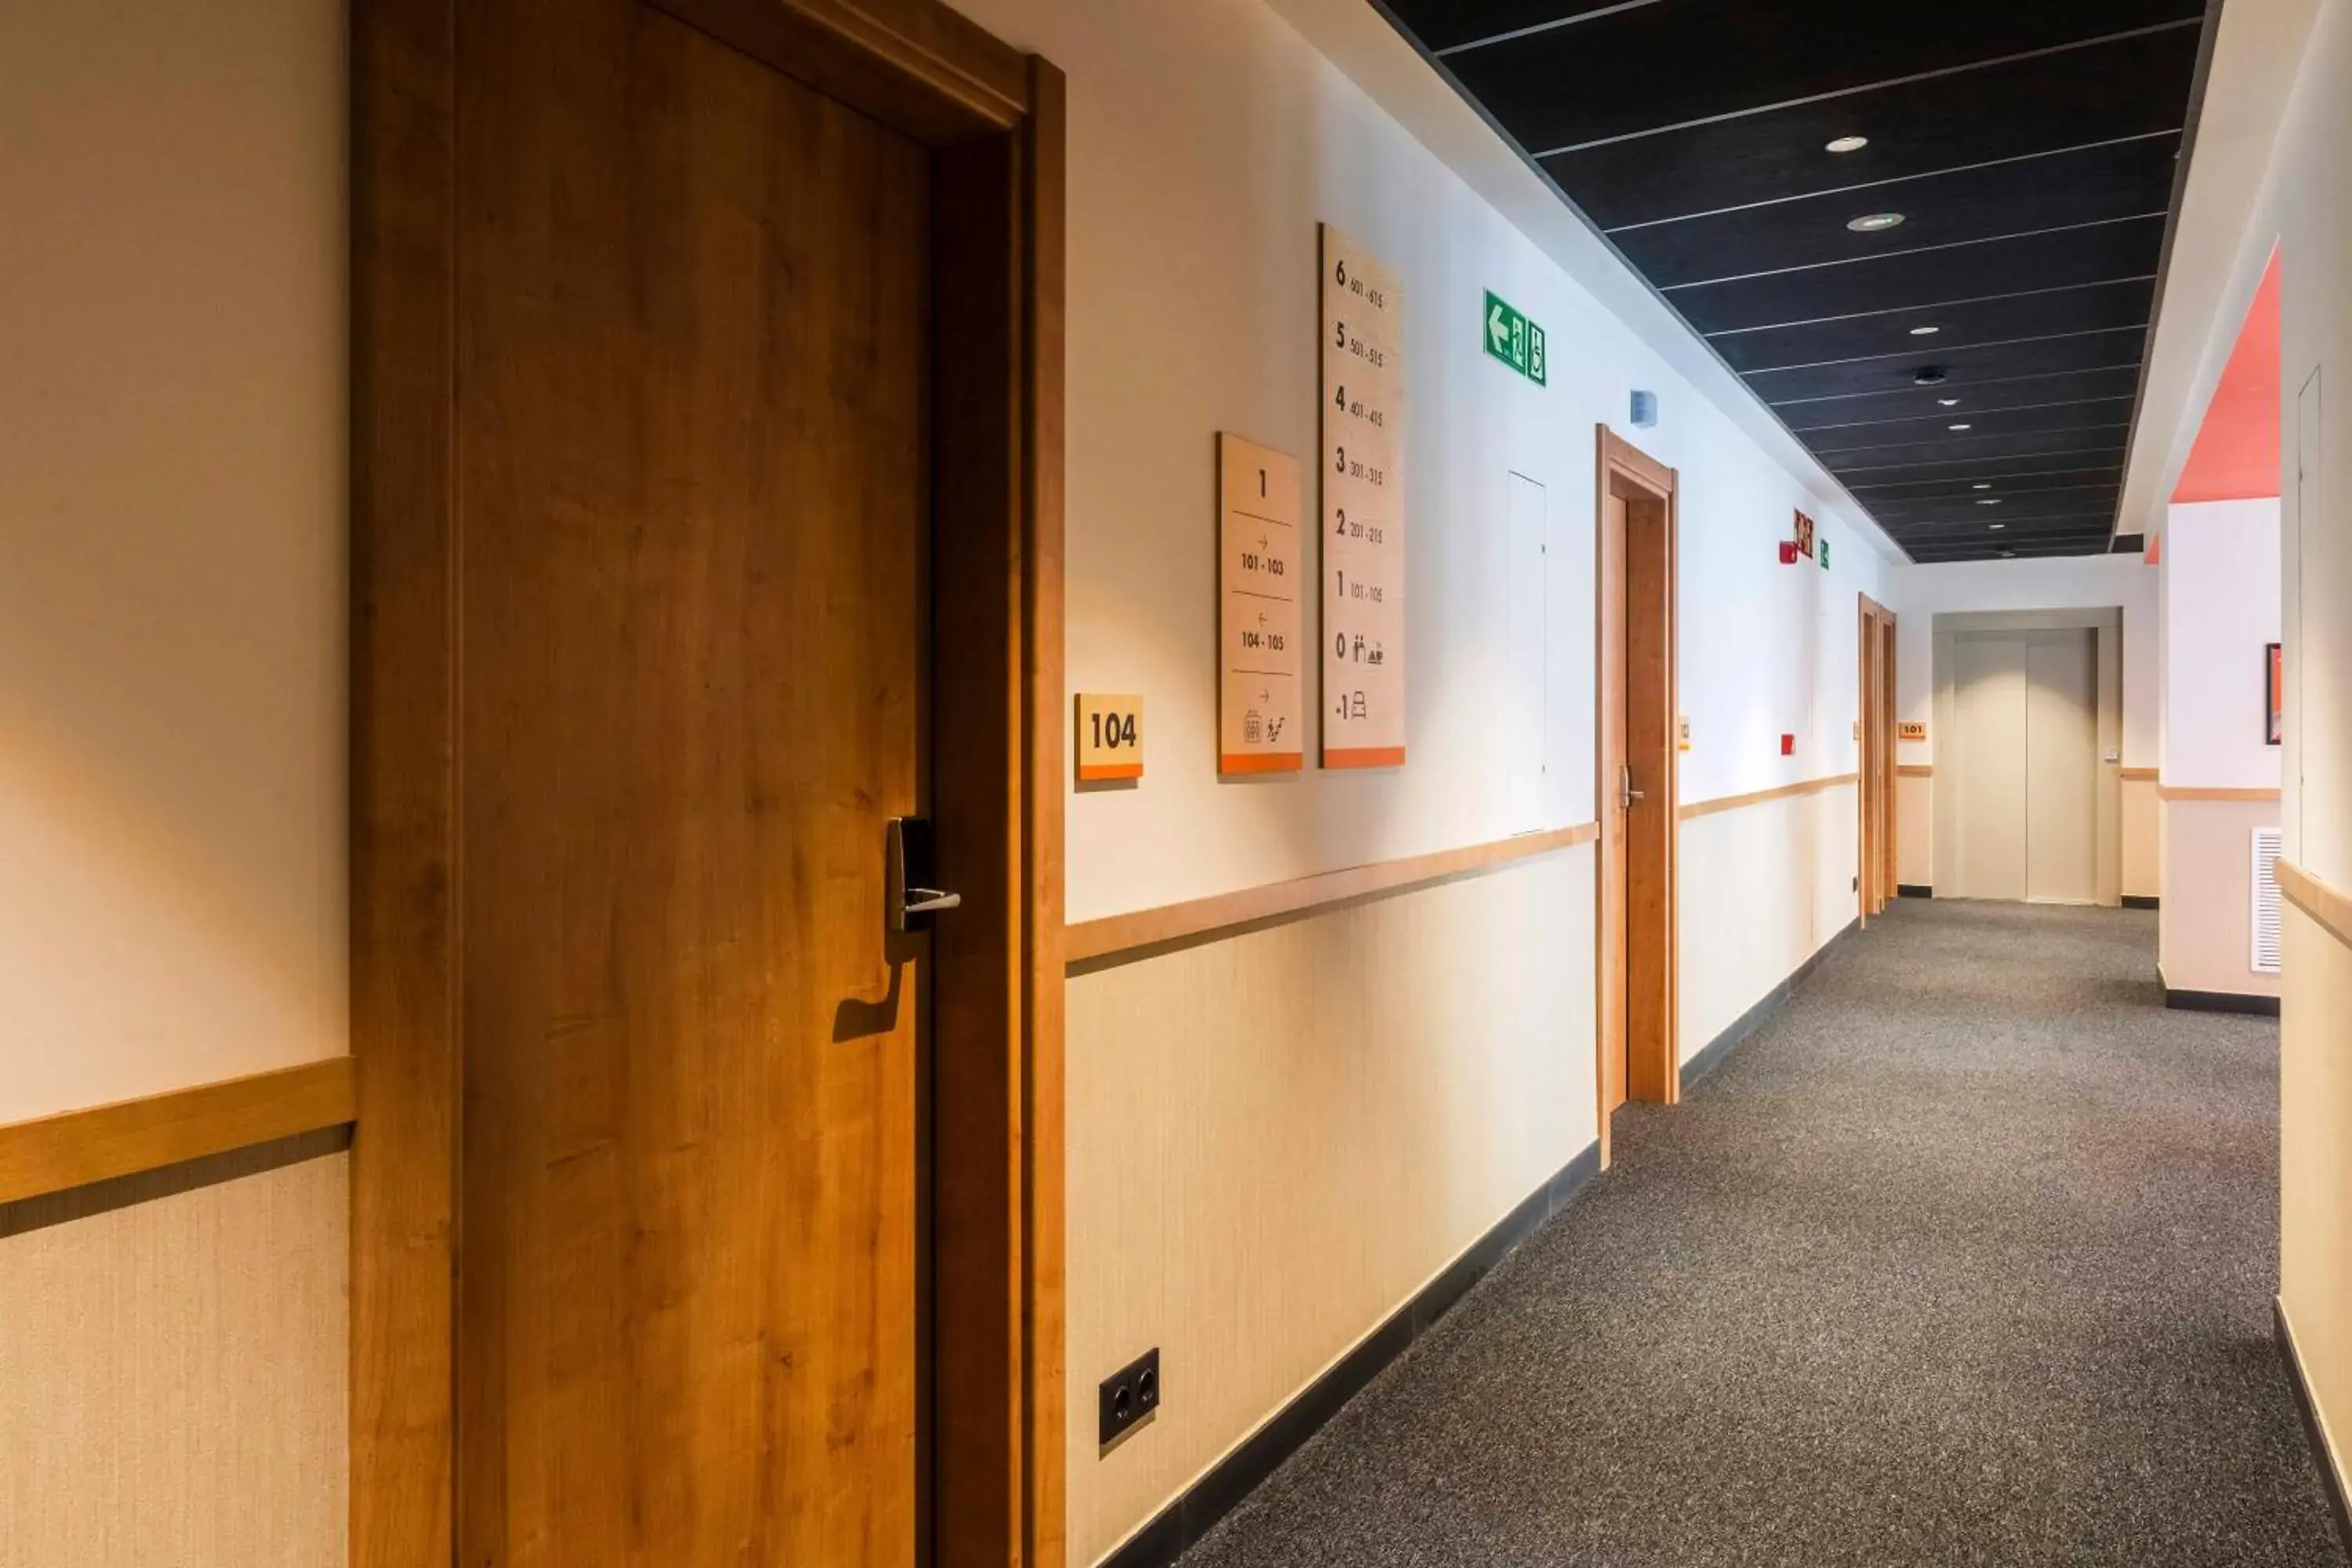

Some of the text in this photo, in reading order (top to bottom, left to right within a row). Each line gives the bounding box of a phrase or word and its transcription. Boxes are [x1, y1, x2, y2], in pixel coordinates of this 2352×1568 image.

[1336, 260, 1345, 287] 6
[1336, 321, 1345, 348] 5
[1351, 338, 1363, 358] 501
[1335, 385, 1345, 412] 4
[1336, 446, 1345, 473] 3
[1350, 461, 1363, 478] 301
[1259, 469, 1266, 499] 1
[1336, 508, 1345, 535] 2
[1350, 522, 1363, 539] 201
[1242, 553, 1258, 571] 101
[1268, 557, 1284, 576] 103
[1337, 570, 1343, 597] 1
[1242, 631, 1259, 648] 104
[1268, 635, 1284, 651] 105
[1336, 632, 1345, 659] 0
[1091, 712, 1136, 749] 104
